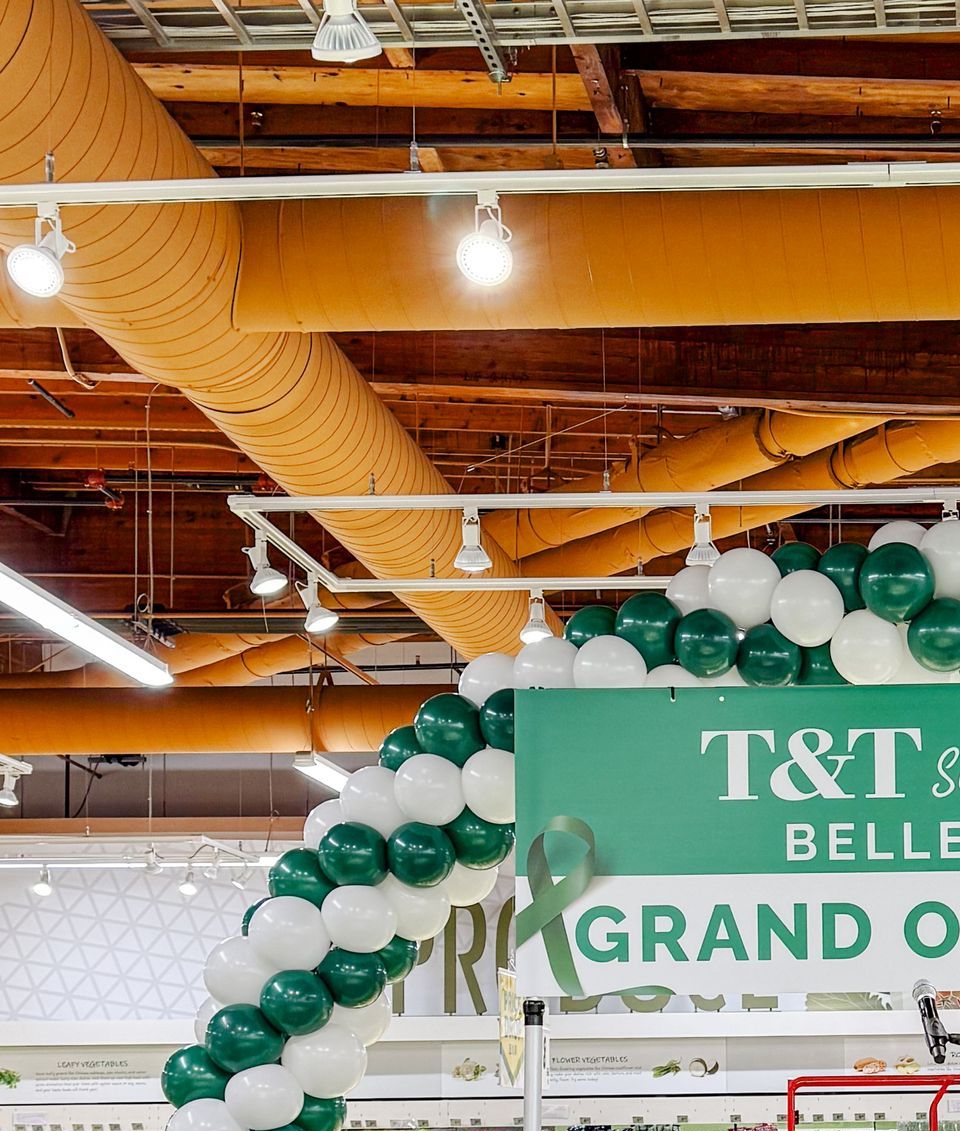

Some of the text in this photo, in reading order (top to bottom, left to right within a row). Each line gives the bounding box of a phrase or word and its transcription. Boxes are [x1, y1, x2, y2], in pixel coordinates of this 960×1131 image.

[701, 728, 922, 801] T&T
[575, 902, 871, 963] GRAND
[81, 1060, 129, 1068] VEGETABLES
[552, 1056, 628, 1064] FLOWER VEGETABLES
